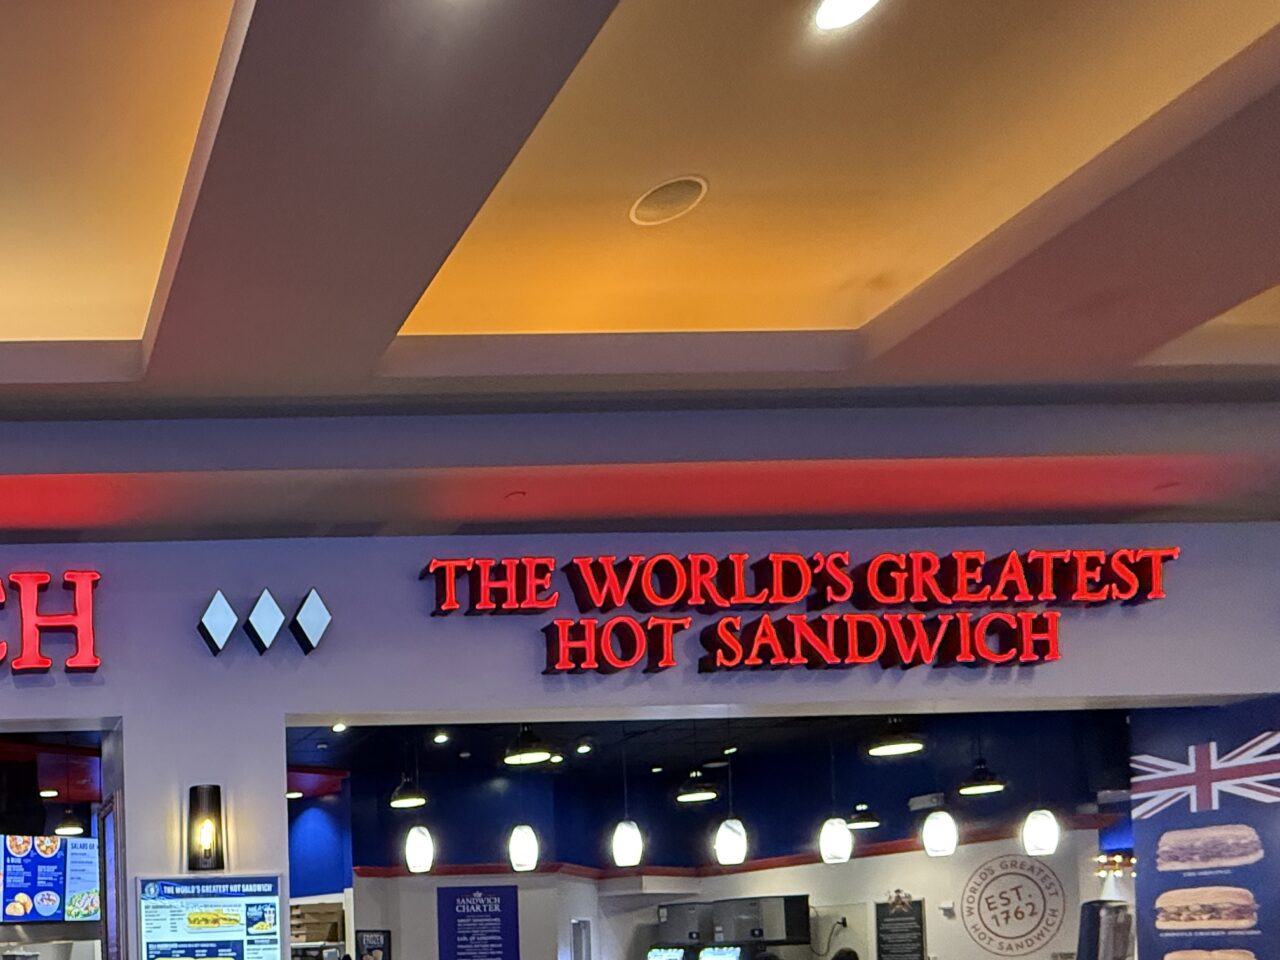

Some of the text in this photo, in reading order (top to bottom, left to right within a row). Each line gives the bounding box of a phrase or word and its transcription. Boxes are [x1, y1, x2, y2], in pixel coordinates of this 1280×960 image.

[429, 546, 1180, 610] THE WORLD'S GREATEST
[554, 611, 1062, 669] HOT SANDWICH
[163, 886, 175, 894] THE
[230, 884, 241, 892] HOT
[242, 883, 273, 892] SANDWICH
[1000, 860, 1059, 897] GREATEST
[456, 897, 501, 905] SANDWICH
[456, 904, 501, 913] CHARTER
[984, 884, 1033, 912] EST.
[991, 901, 1038, 928] 1762
[363, 934, 384, 945] FROZEN
[970, 908, 1059, 953] HOT SANDWICH
